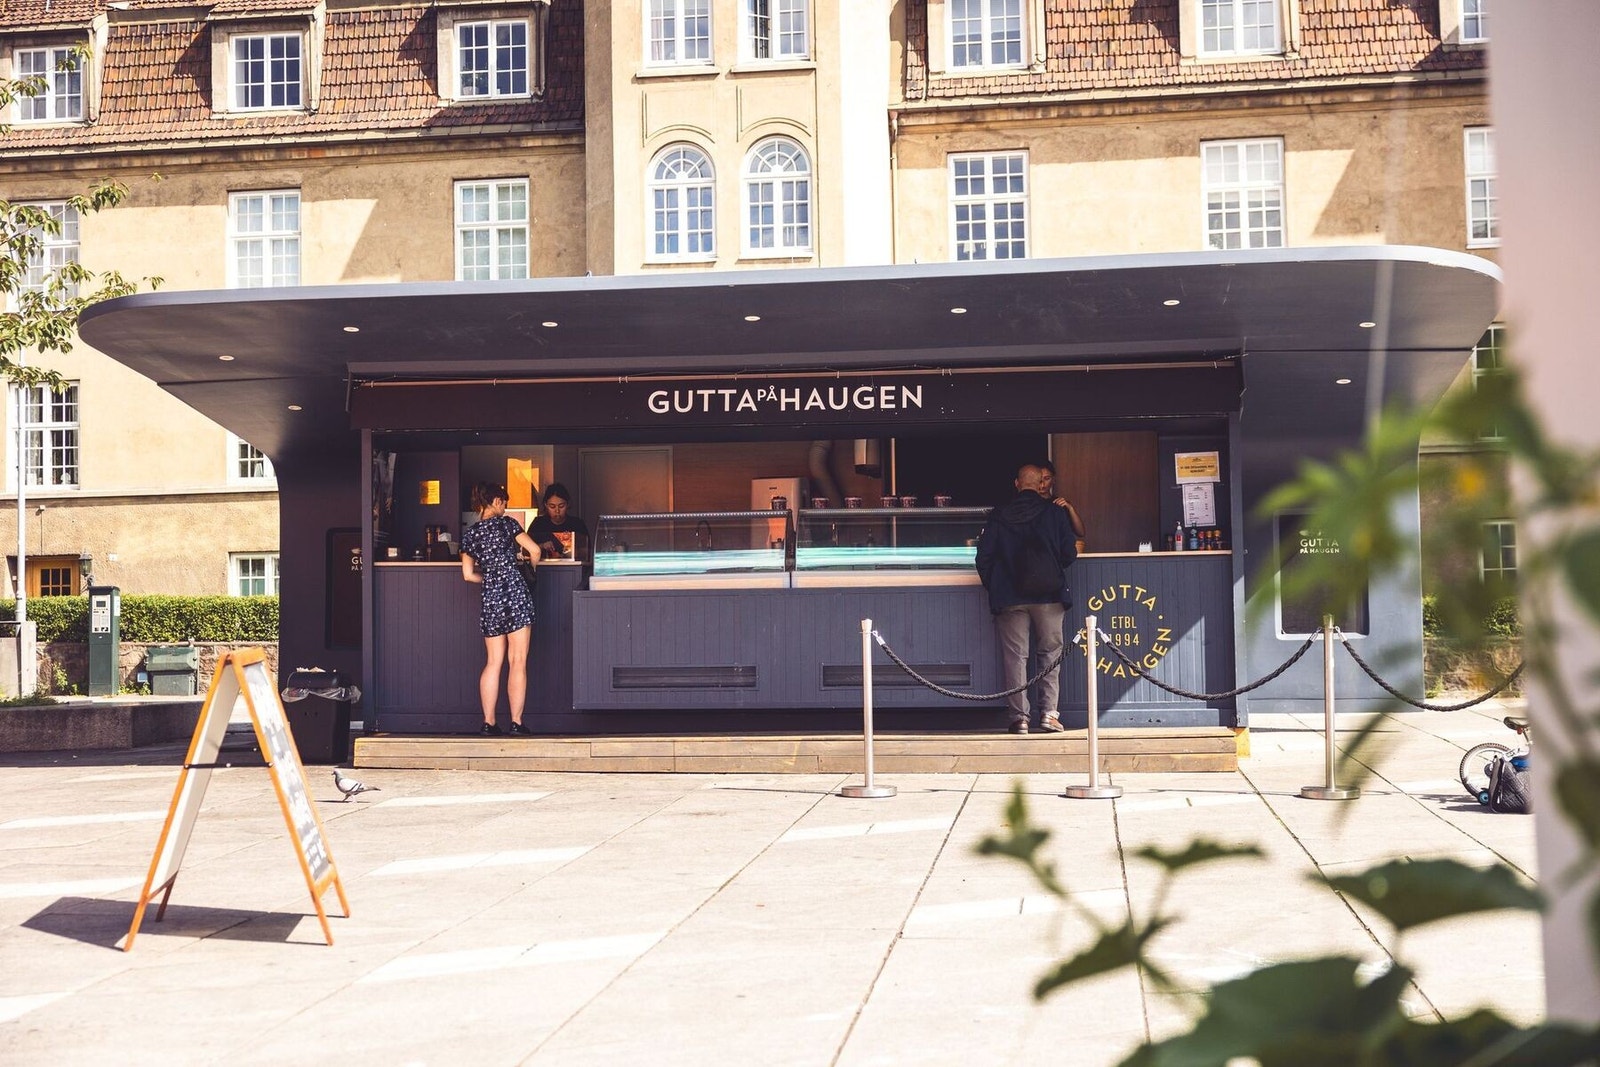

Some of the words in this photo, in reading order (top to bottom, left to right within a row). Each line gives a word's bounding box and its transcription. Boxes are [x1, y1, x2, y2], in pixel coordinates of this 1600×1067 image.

[648, 389, 758, 414] GUTTA
[757, 385, 778, 401] PÅ
[780, 385, 922, 411] HAUGEN
[1088, 585, 1156, 611] GUTTA
[1111, 616, 1137, 629] ETBL
[1096, 628, 1172, 678] HAUGEN
